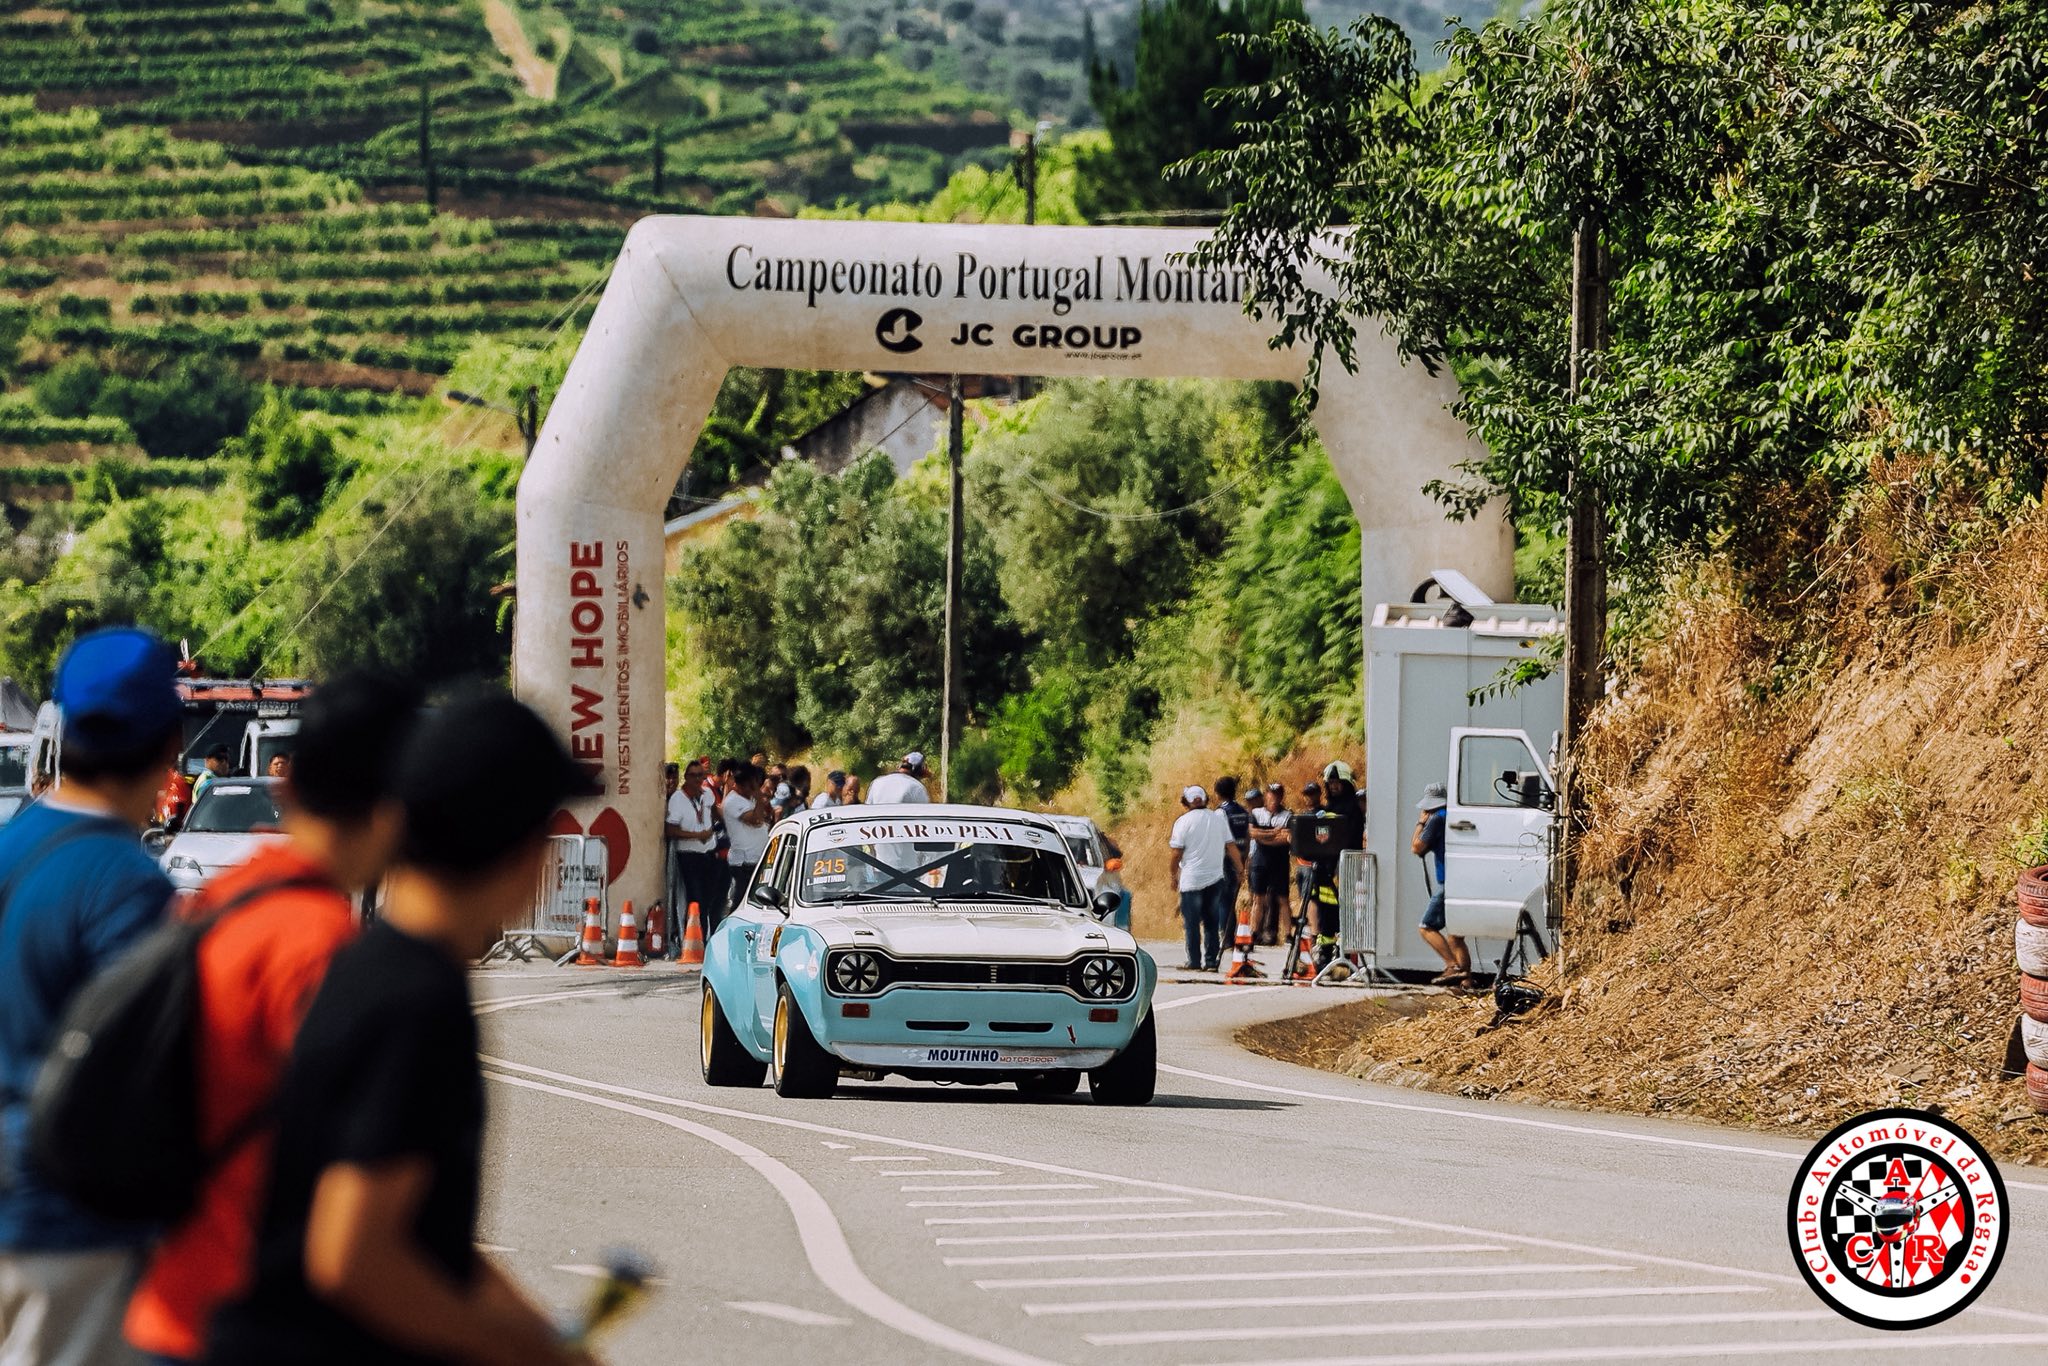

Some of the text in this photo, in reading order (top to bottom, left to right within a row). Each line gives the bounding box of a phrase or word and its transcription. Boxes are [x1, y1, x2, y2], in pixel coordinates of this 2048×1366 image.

[726, 244, 1254, 316] Campeonato Portugal Montan
[950, 322, 1142, 349] JC GROUP
[570, 540, 604, 668] HOPE
[615, 540, 631, 795] INVESTIMENTOS IMOBILIÁRIOS
[859, 824, 930, 841] SOLAR
[958, 825, 1014, 841] PENA
[813, 859, 846, 876] 215
[927, 1049, 1058, 1064] MOUTINHO MOTORSPORT
